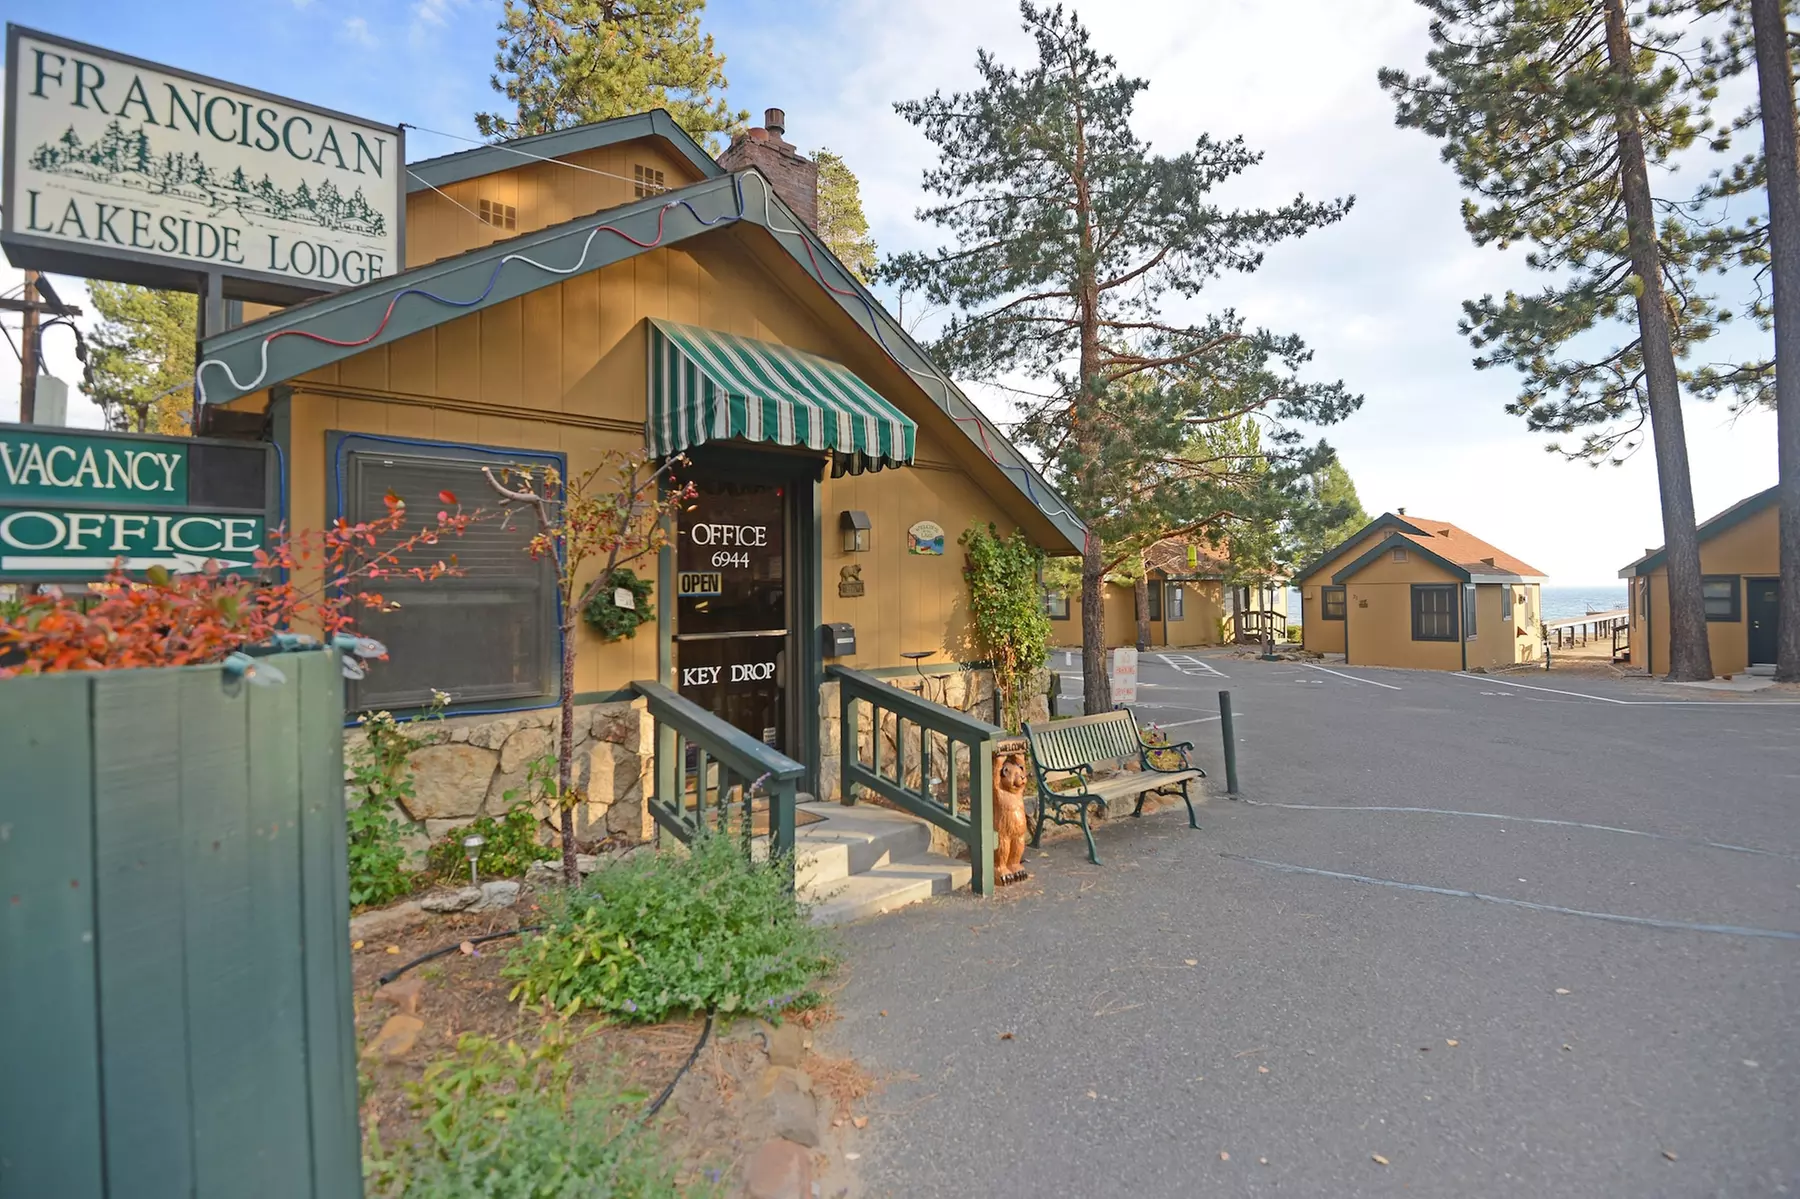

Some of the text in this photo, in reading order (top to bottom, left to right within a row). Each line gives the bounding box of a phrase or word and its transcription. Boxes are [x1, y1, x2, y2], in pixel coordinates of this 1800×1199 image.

[28, 47, 387, 180] FRANCISCAN
[27, 189, 384, 285] LAKESIDE LODGE
[0, 441, 182, 492] VACANCY
[0, 511, 260, 552] OFFICE
[691, 523, 768, 547] OFFICE
[711, 551, 750, 568] 6944
[681, 573, 719, 593] OPEN
[683, 662, 776, 686] KEY DROP
